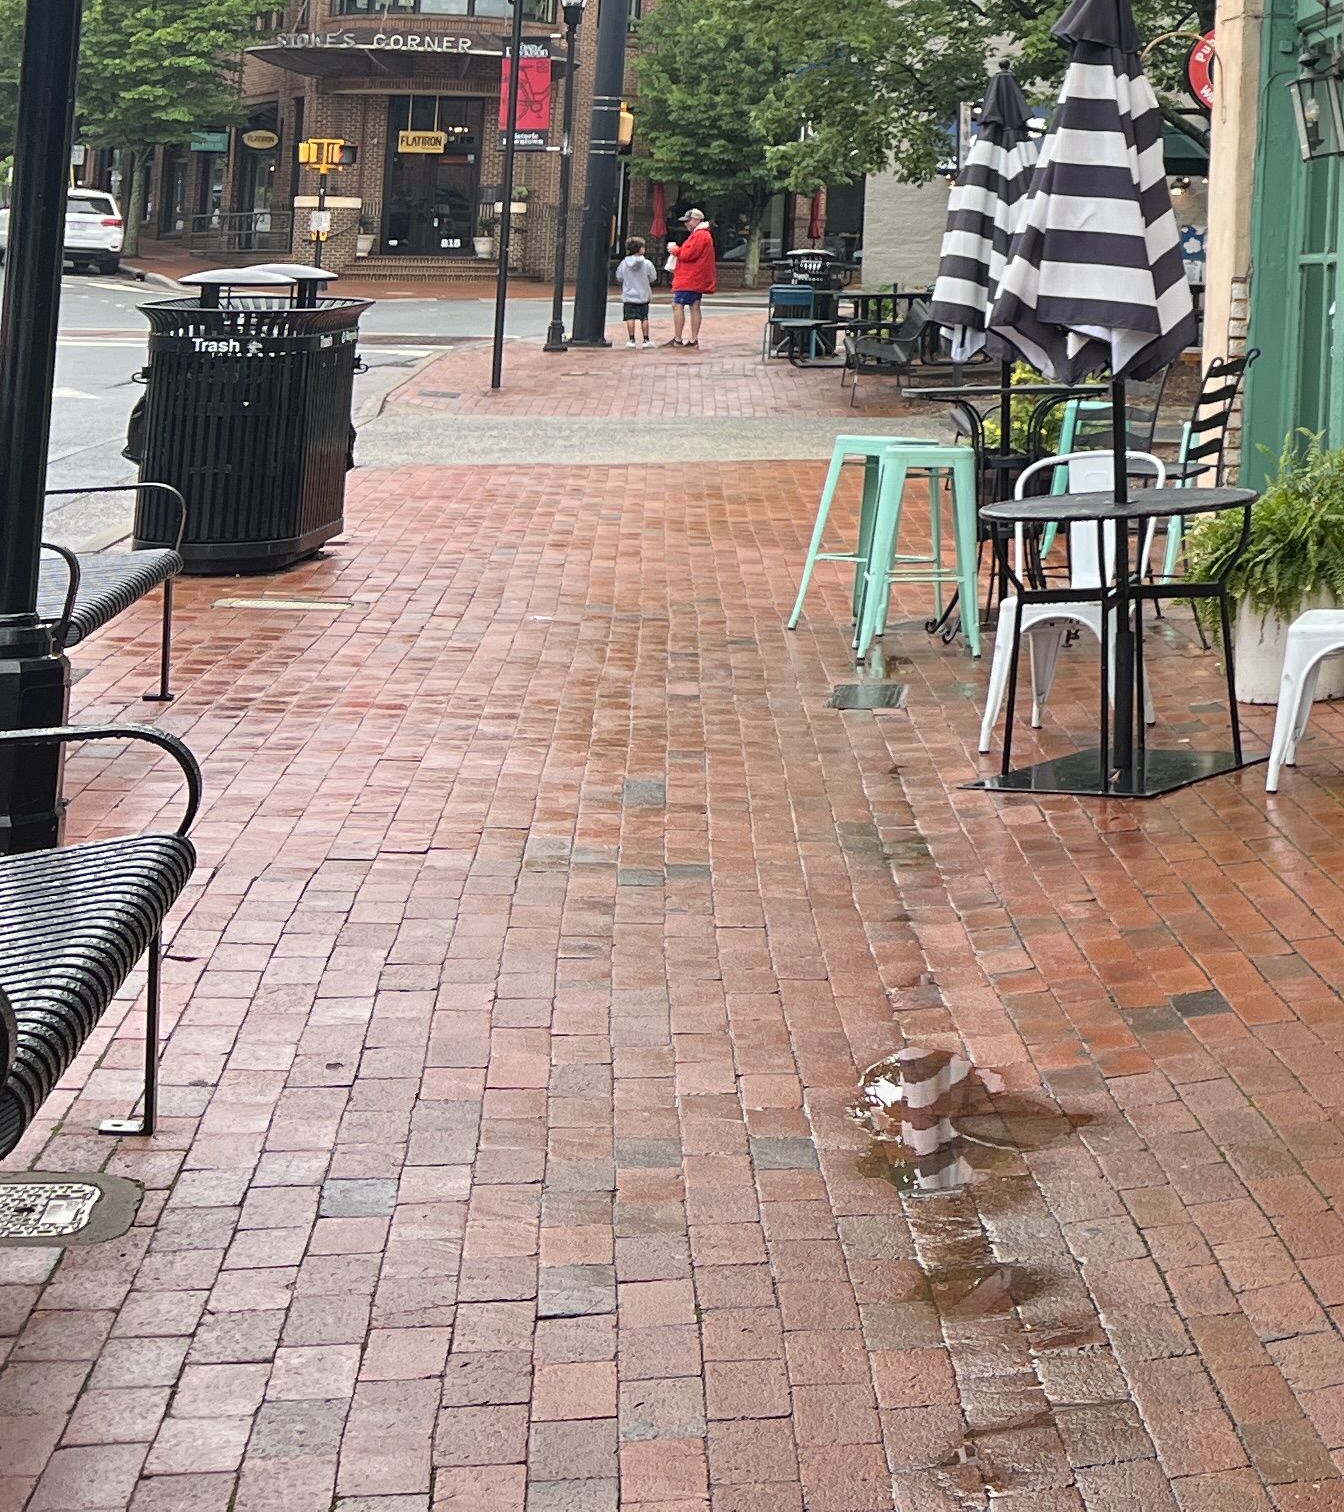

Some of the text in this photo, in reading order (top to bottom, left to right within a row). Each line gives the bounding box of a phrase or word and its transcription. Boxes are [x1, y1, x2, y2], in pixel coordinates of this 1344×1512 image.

[373, 34, 472, 53] CORNER
[400, 135, 442, 147] FLATIRON
[191, 337, 241, 353] Trash
